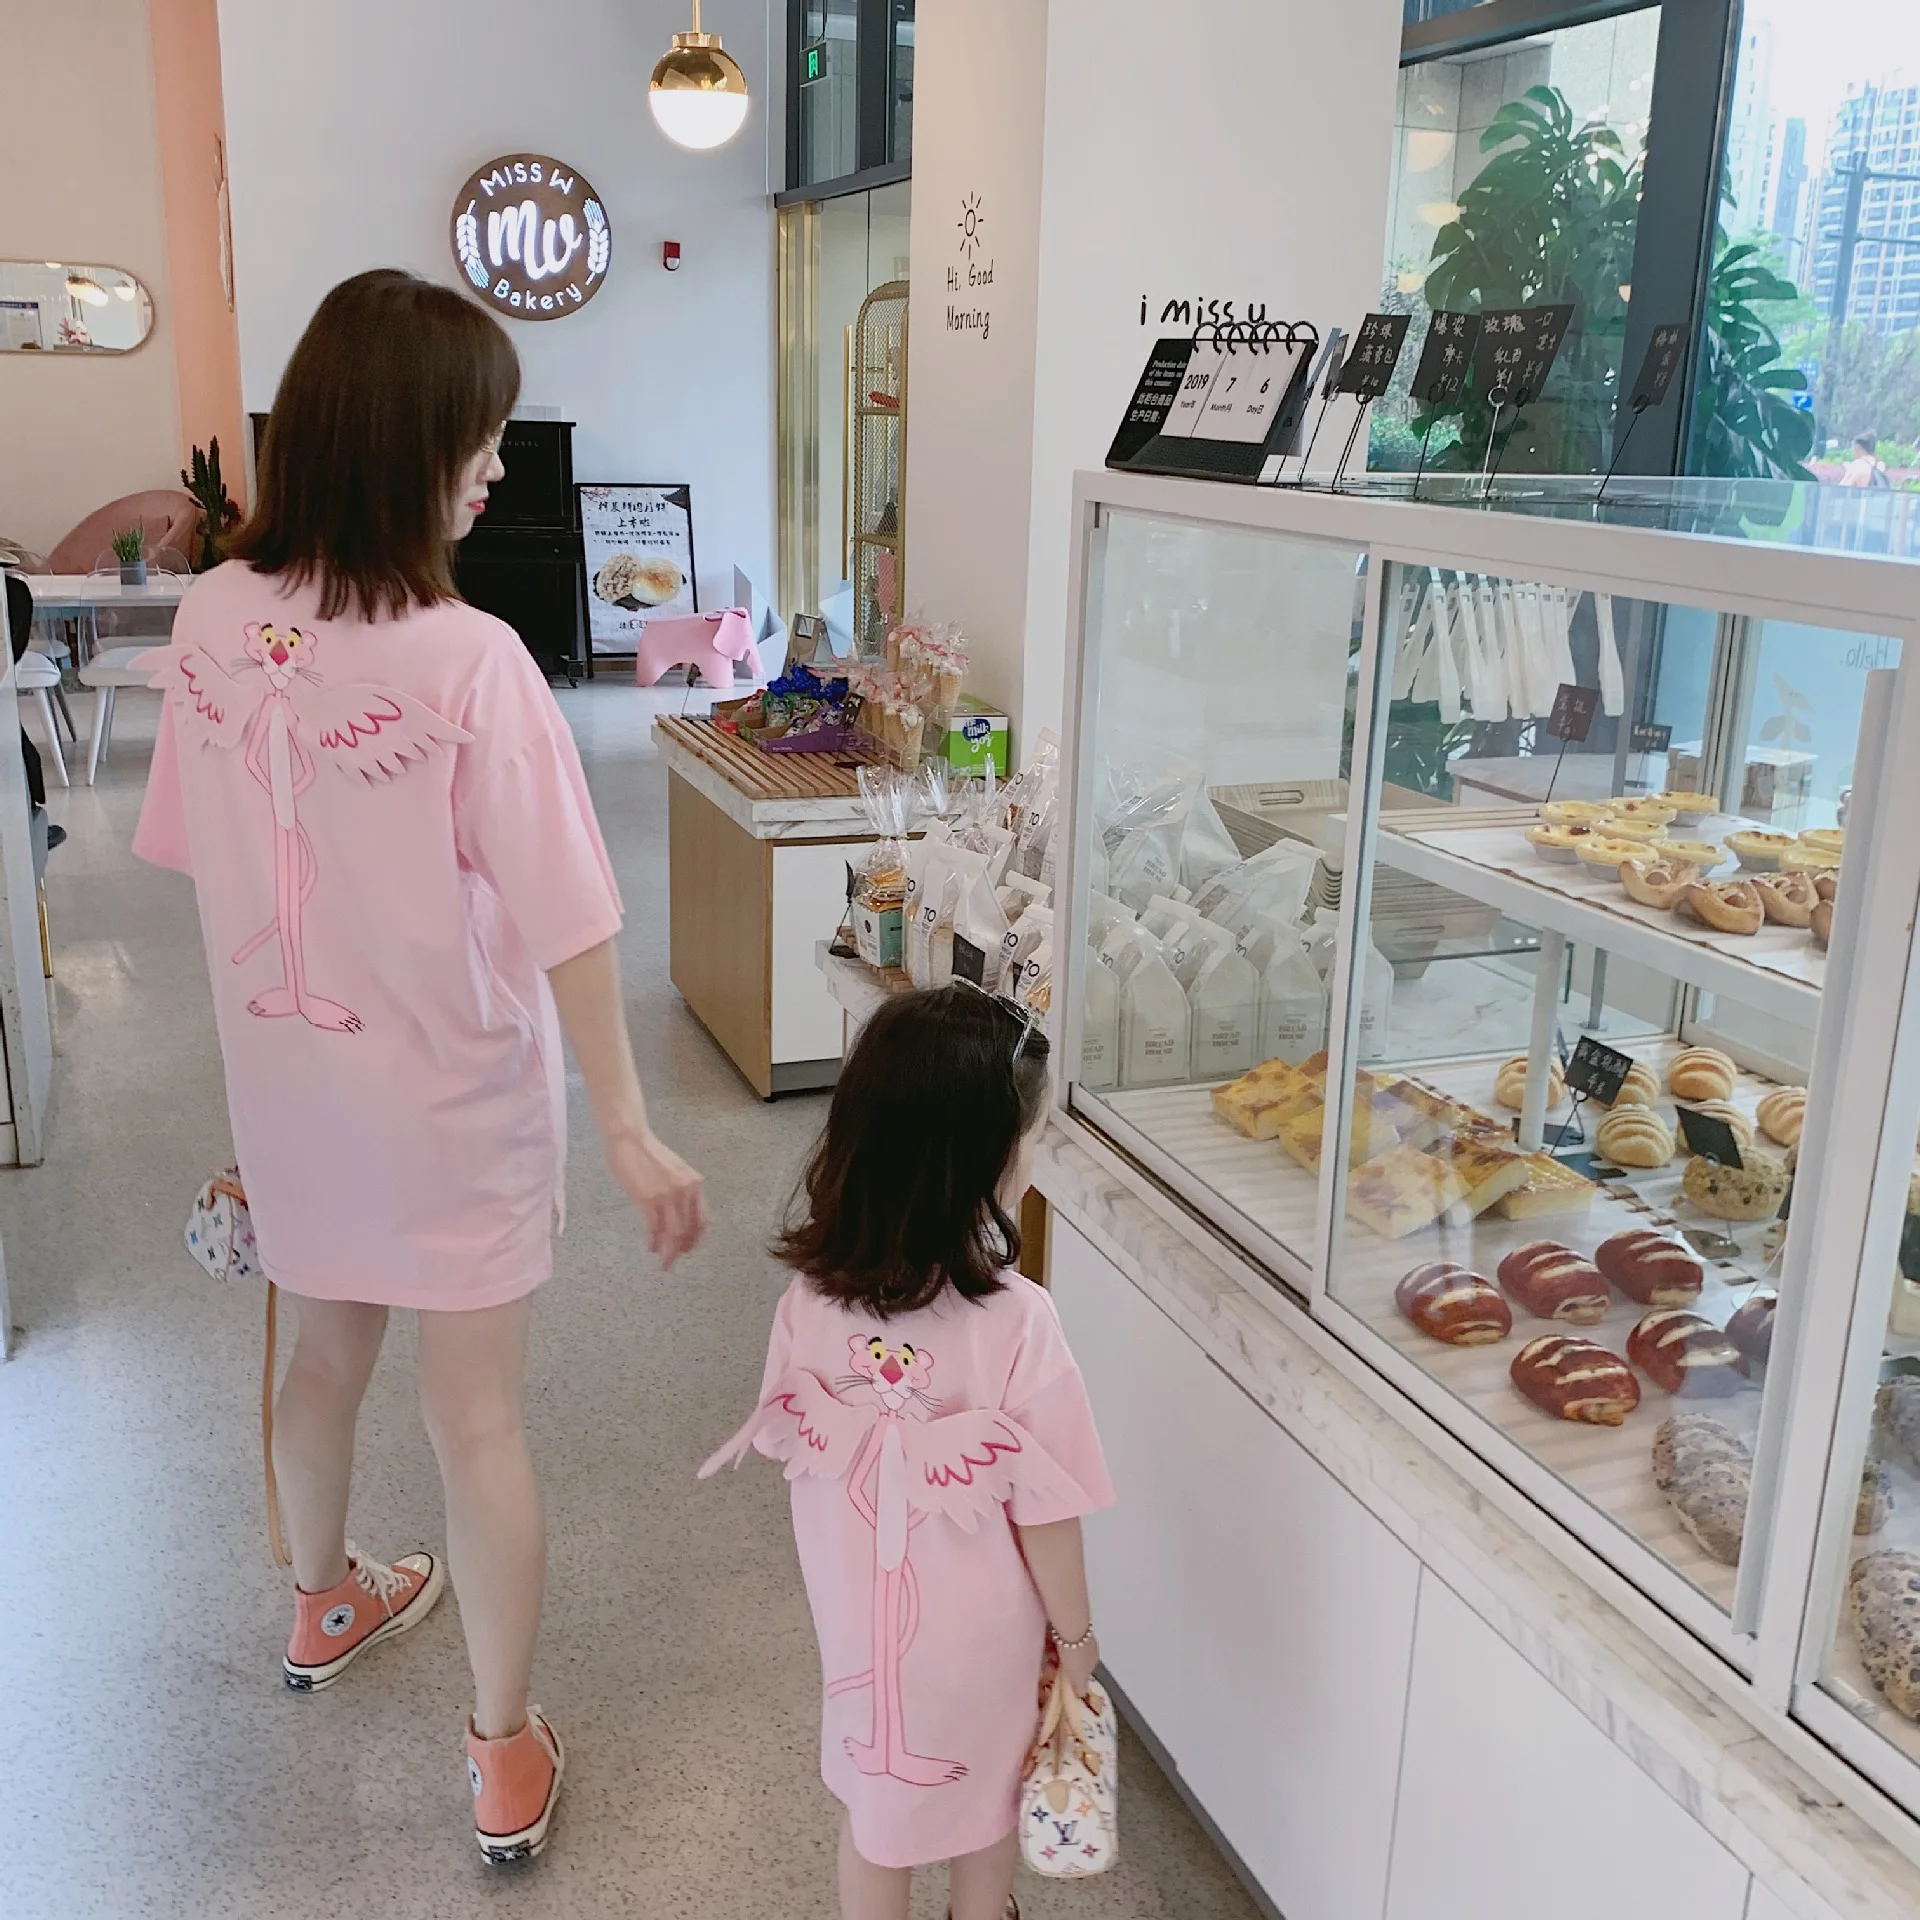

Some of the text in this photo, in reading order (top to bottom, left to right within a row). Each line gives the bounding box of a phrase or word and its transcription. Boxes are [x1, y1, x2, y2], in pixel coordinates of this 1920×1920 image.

[480, 162, 574, 196] MISS W
[969, 259, 994, 287] Good
[493, 278, 583, 310] Bakery
[946, 305, 990, 339] Morning
[1161, 296, 1235, 325] miss
[1248, 303, 1266, 323] u
[1363, 321, 1393, 340] 珍珠
[1484, 313, 1526, 335] 玫瑰
[1184, 374, 1210, 390] 2019
[1225, 377, 1237, 393] 7
[1259, 377, 1271, 394] 6
